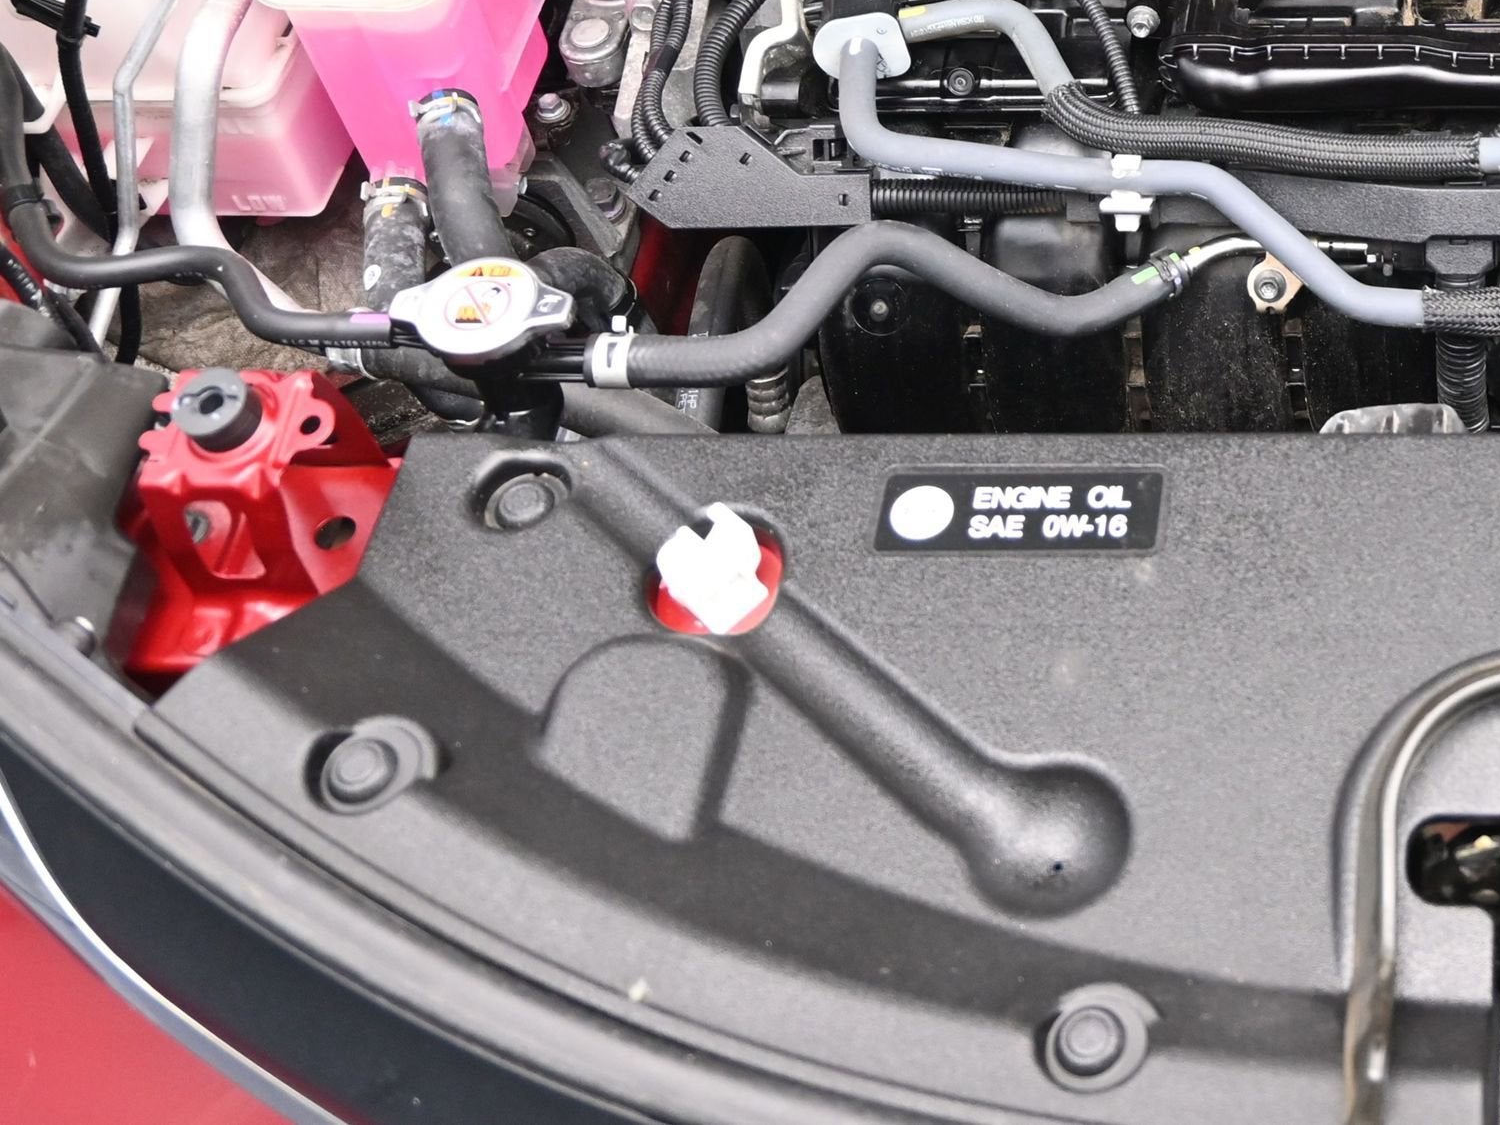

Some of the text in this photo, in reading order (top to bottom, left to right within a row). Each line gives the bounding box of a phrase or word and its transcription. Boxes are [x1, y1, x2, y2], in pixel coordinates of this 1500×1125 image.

[231, 194, 288, 212] LOW
[972, 485, 1132, 509] ENGINE OIL
[967, 514, 1128, 539] SAE 0W-16
